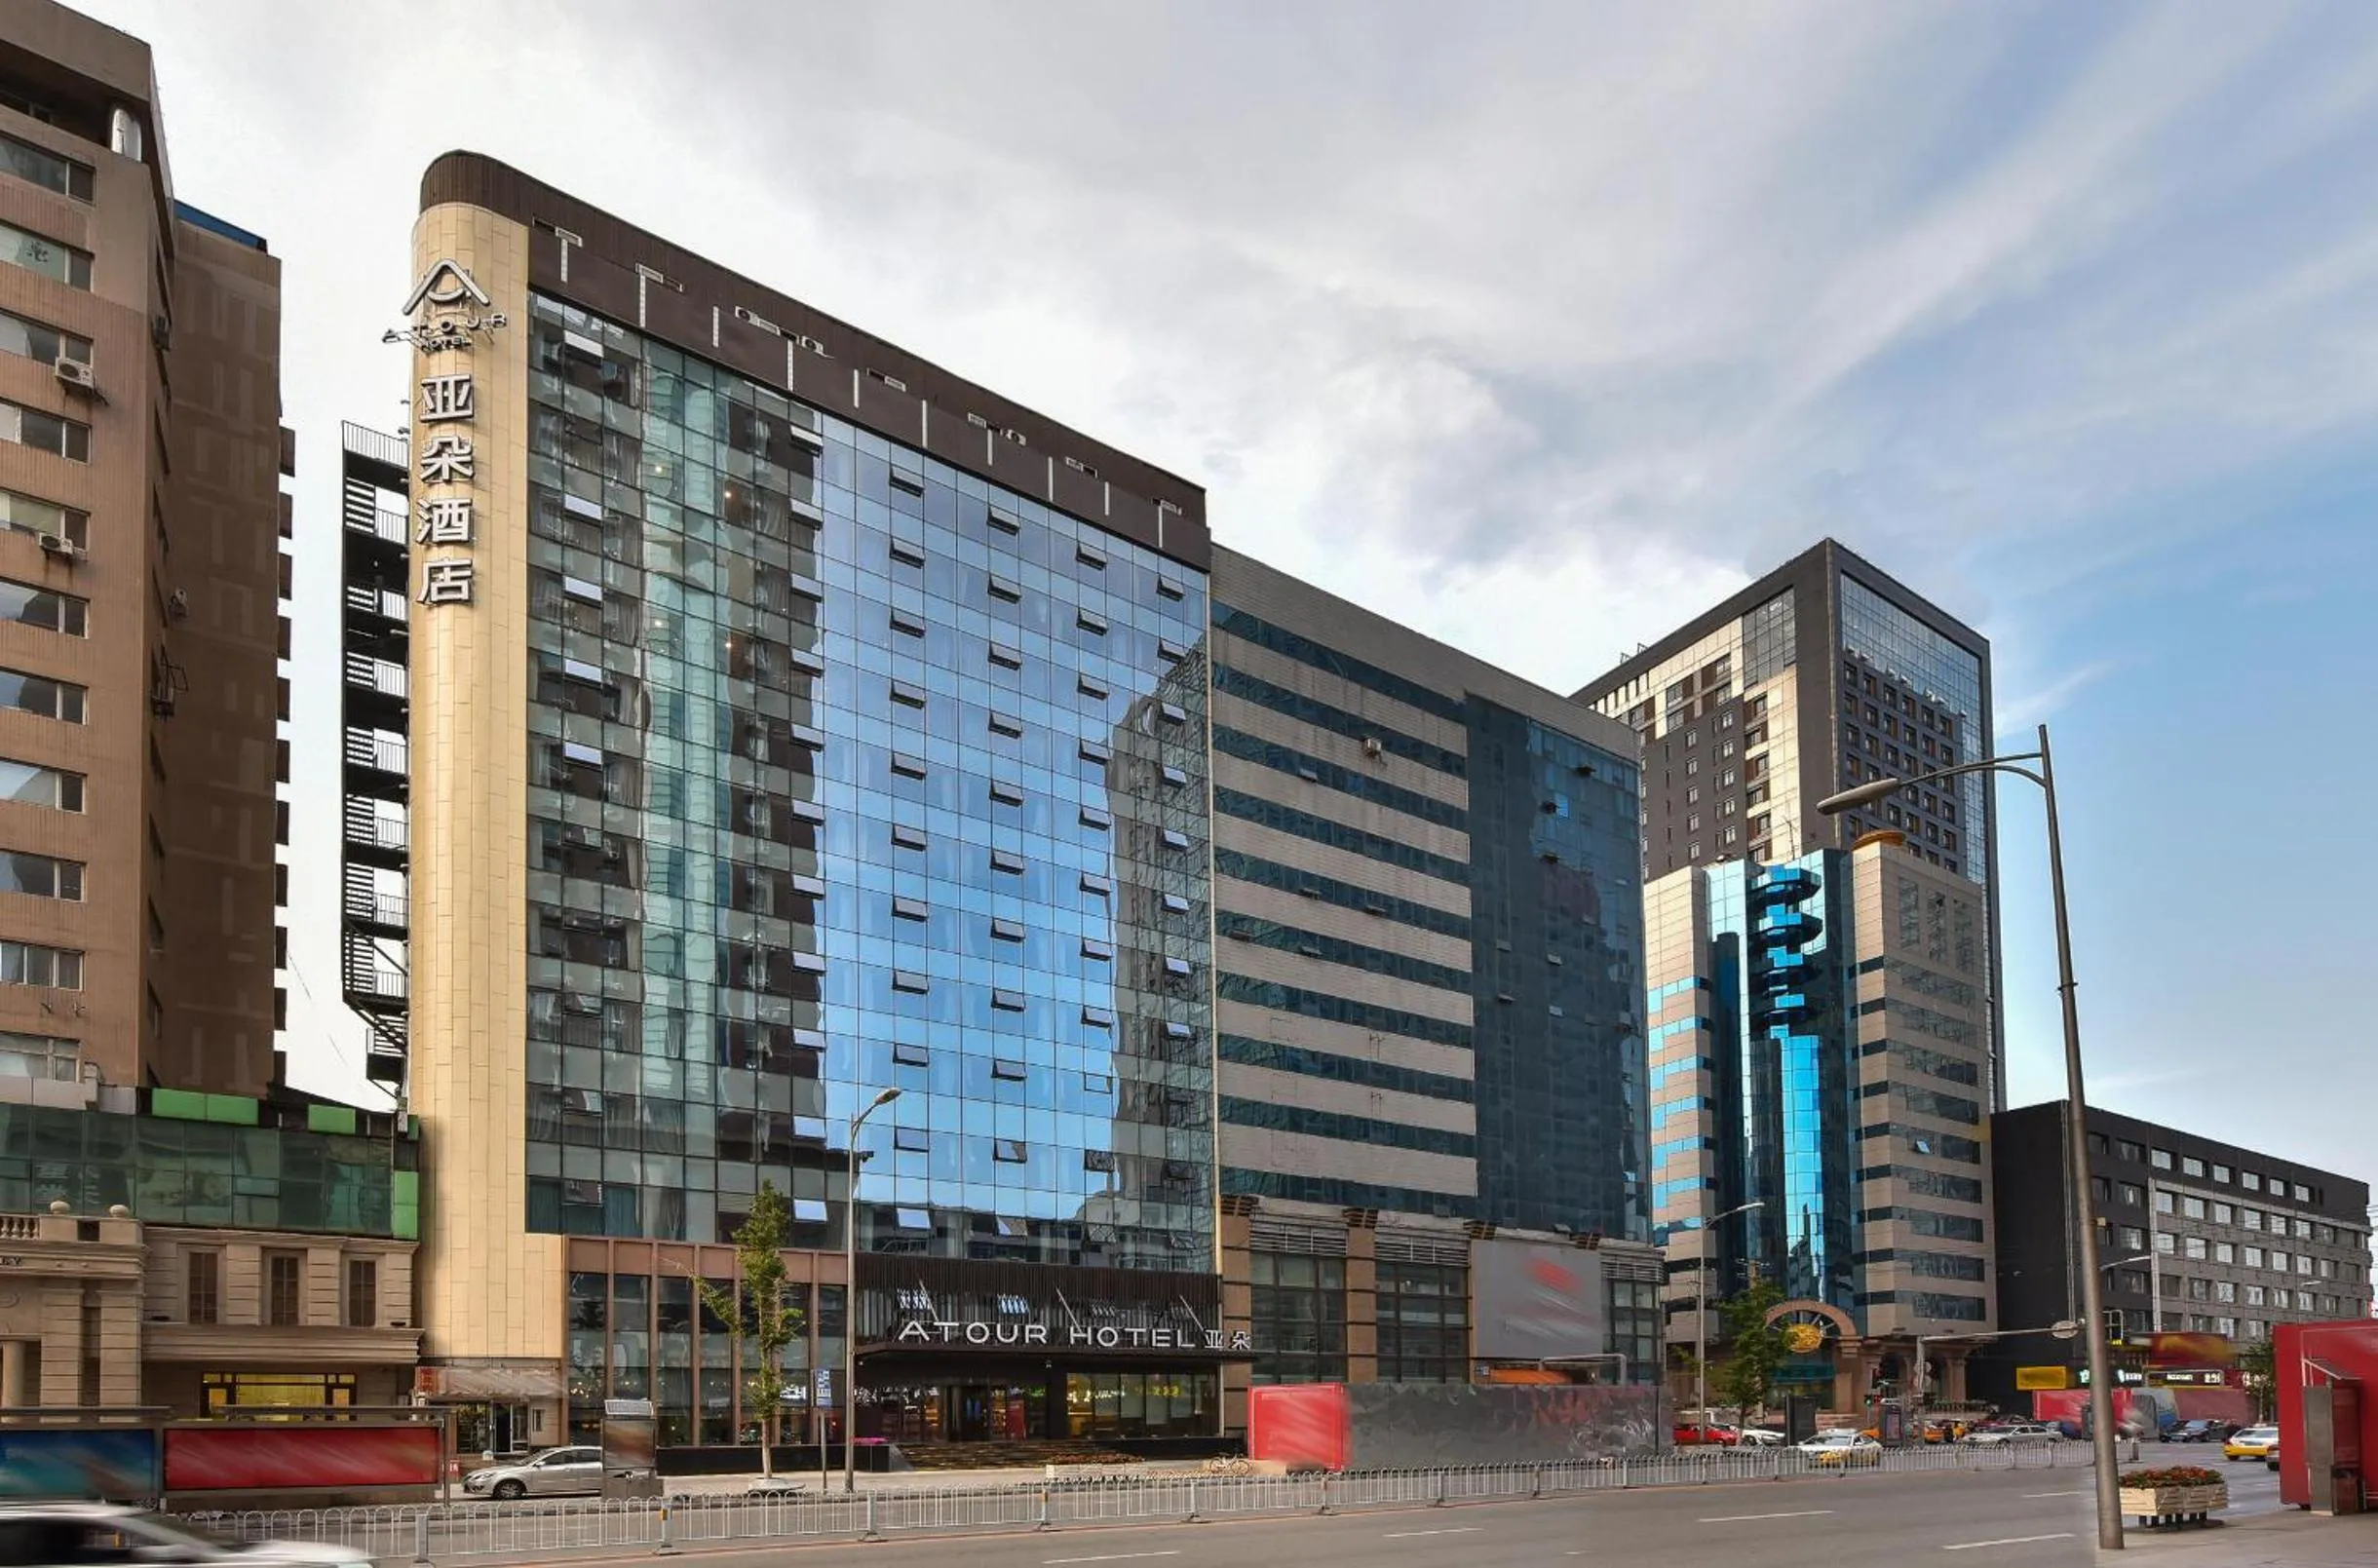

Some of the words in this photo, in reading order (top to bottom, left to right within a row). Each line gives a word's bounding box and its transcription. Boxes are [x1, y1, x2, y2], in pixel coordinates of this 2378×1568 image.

[416, 374, 475, 605] 亚朵酒店
[898, 1319, 1048, 1344] ATOUR
[1069, 1326, 1196, 1348] HOTEL
[1204, 1329, 1251, 1351] 亚朵
